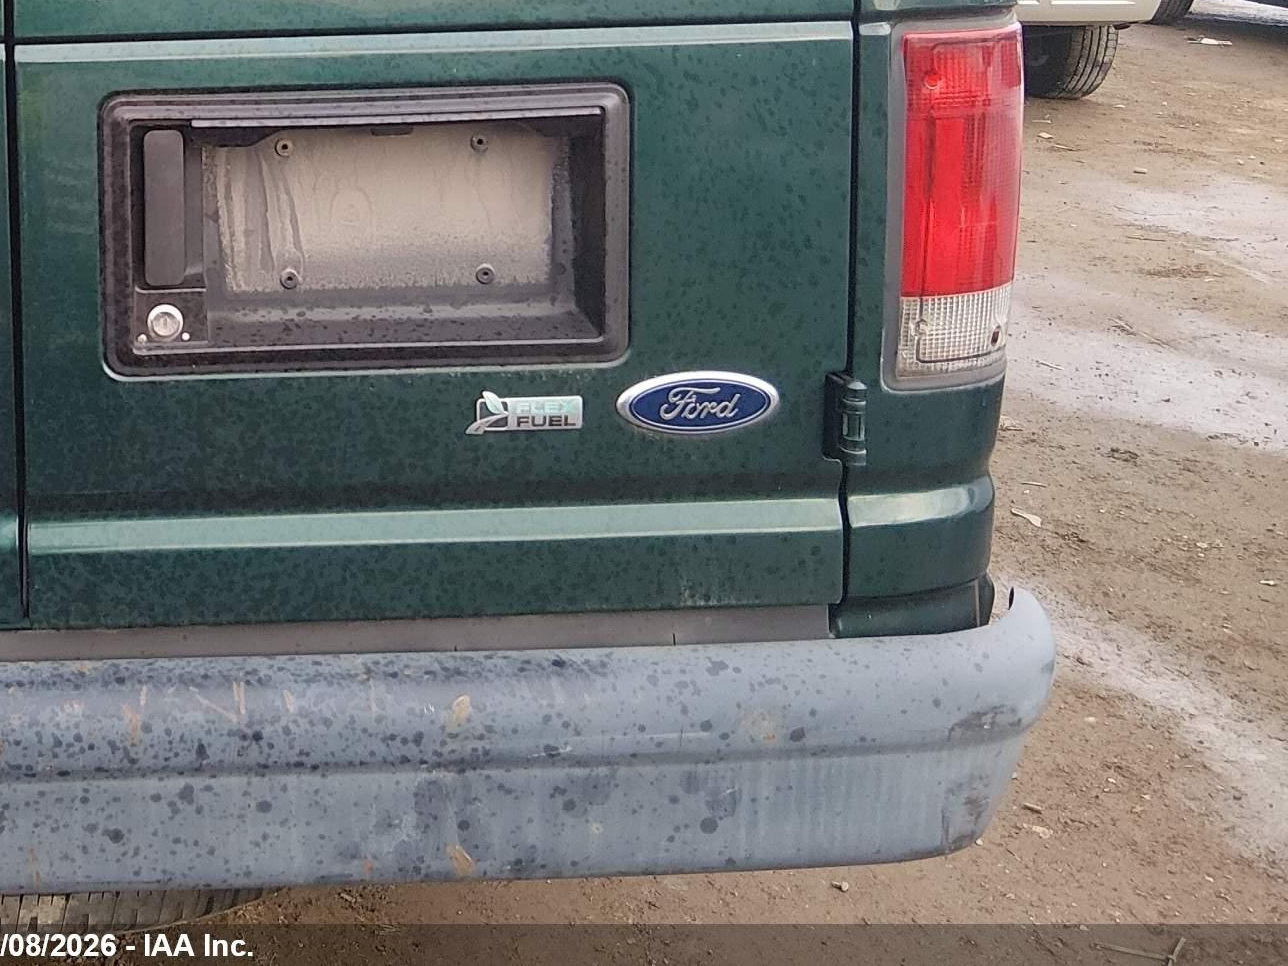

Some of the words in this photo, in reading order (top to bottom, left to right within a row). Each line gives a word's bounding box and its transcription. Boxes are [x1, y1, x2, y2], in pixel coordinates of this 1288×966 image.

[516, 400, 577, 414] FLEX
[660, 385, 741, 419] Ford
[516, 414, 577, 428] FUEL
